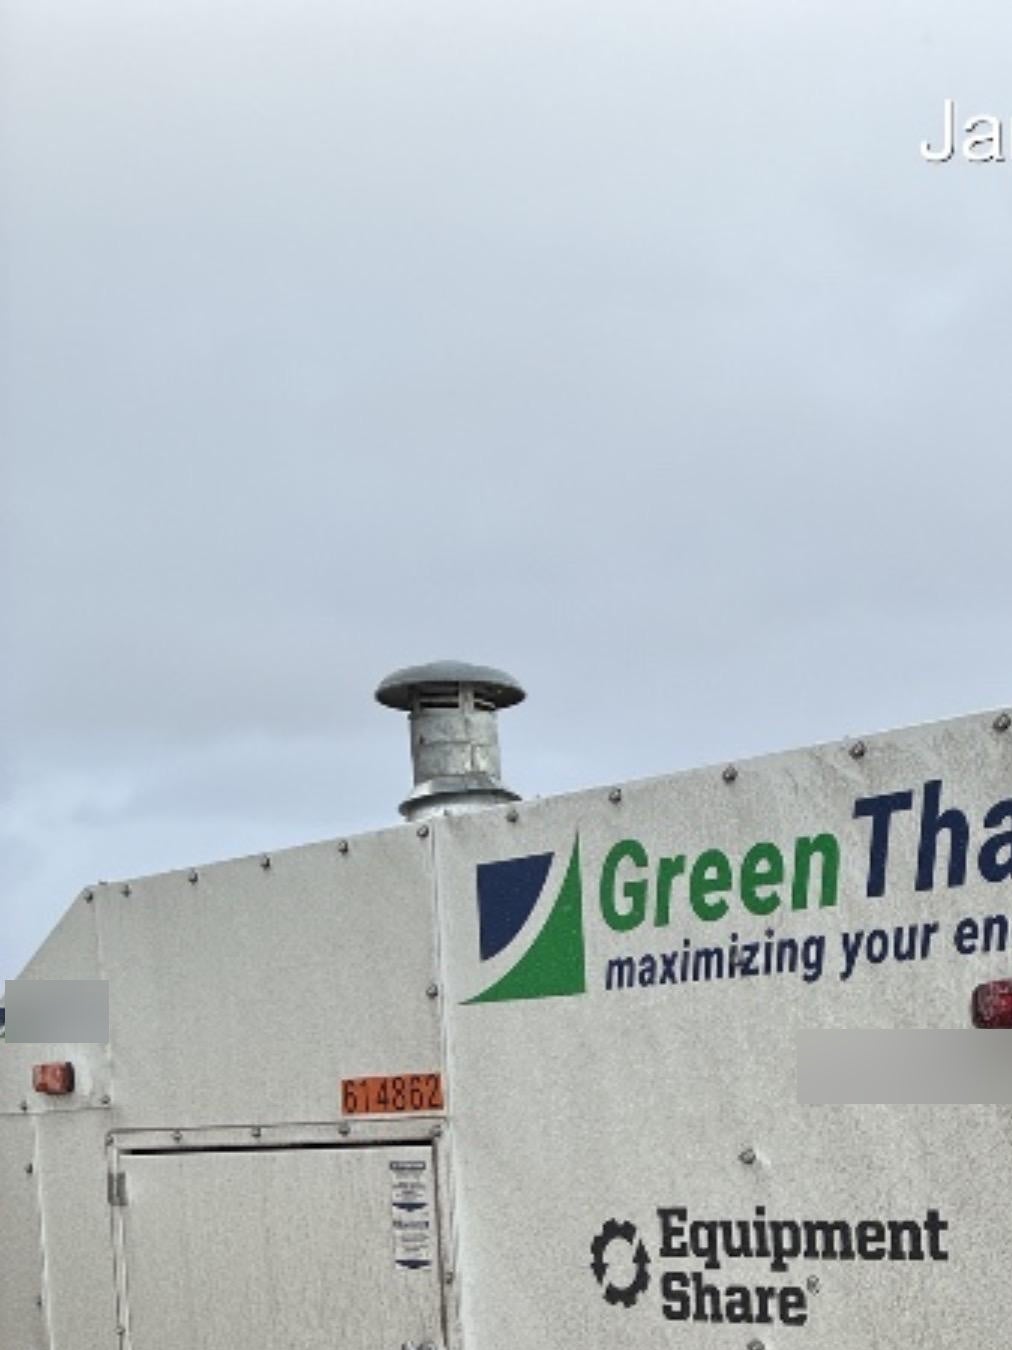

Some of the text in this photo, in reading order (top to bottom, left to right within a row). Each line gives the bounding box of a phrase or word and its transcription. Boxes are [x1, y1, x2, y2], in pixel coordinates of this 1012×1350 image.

[605, 928, 825, 992] maximizing
[838, 919, 938, 982] your
[342, 1074, 441, 1114] 614862
[656, 1205, 949, 1272] Equipment
